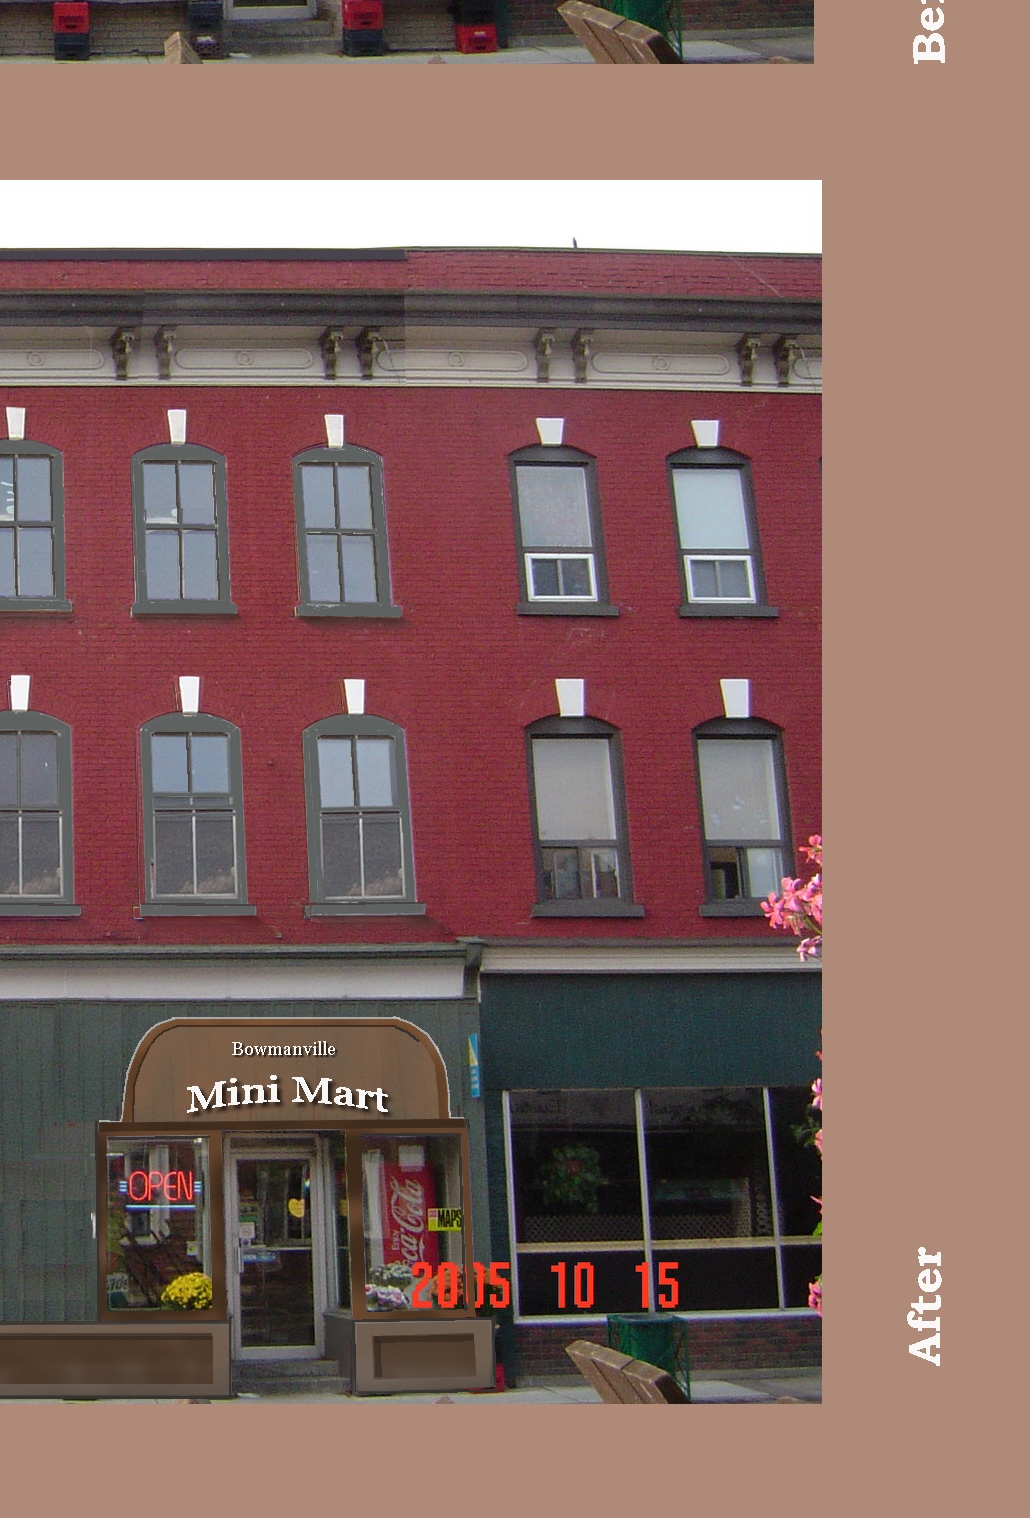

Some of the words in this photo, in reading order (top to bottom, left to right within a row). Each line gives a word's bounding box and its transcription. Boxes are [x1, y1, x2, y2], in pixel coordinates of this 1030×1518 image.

[231, 1040, 337, 1056] Bowmanville
[186, 1074, 281, 1114] Mini
[291, 1076, 389, 1113] Mart
[128, 1170, 194, 1202] OPEN
[437, 1209, 462, 1228] MAPS
